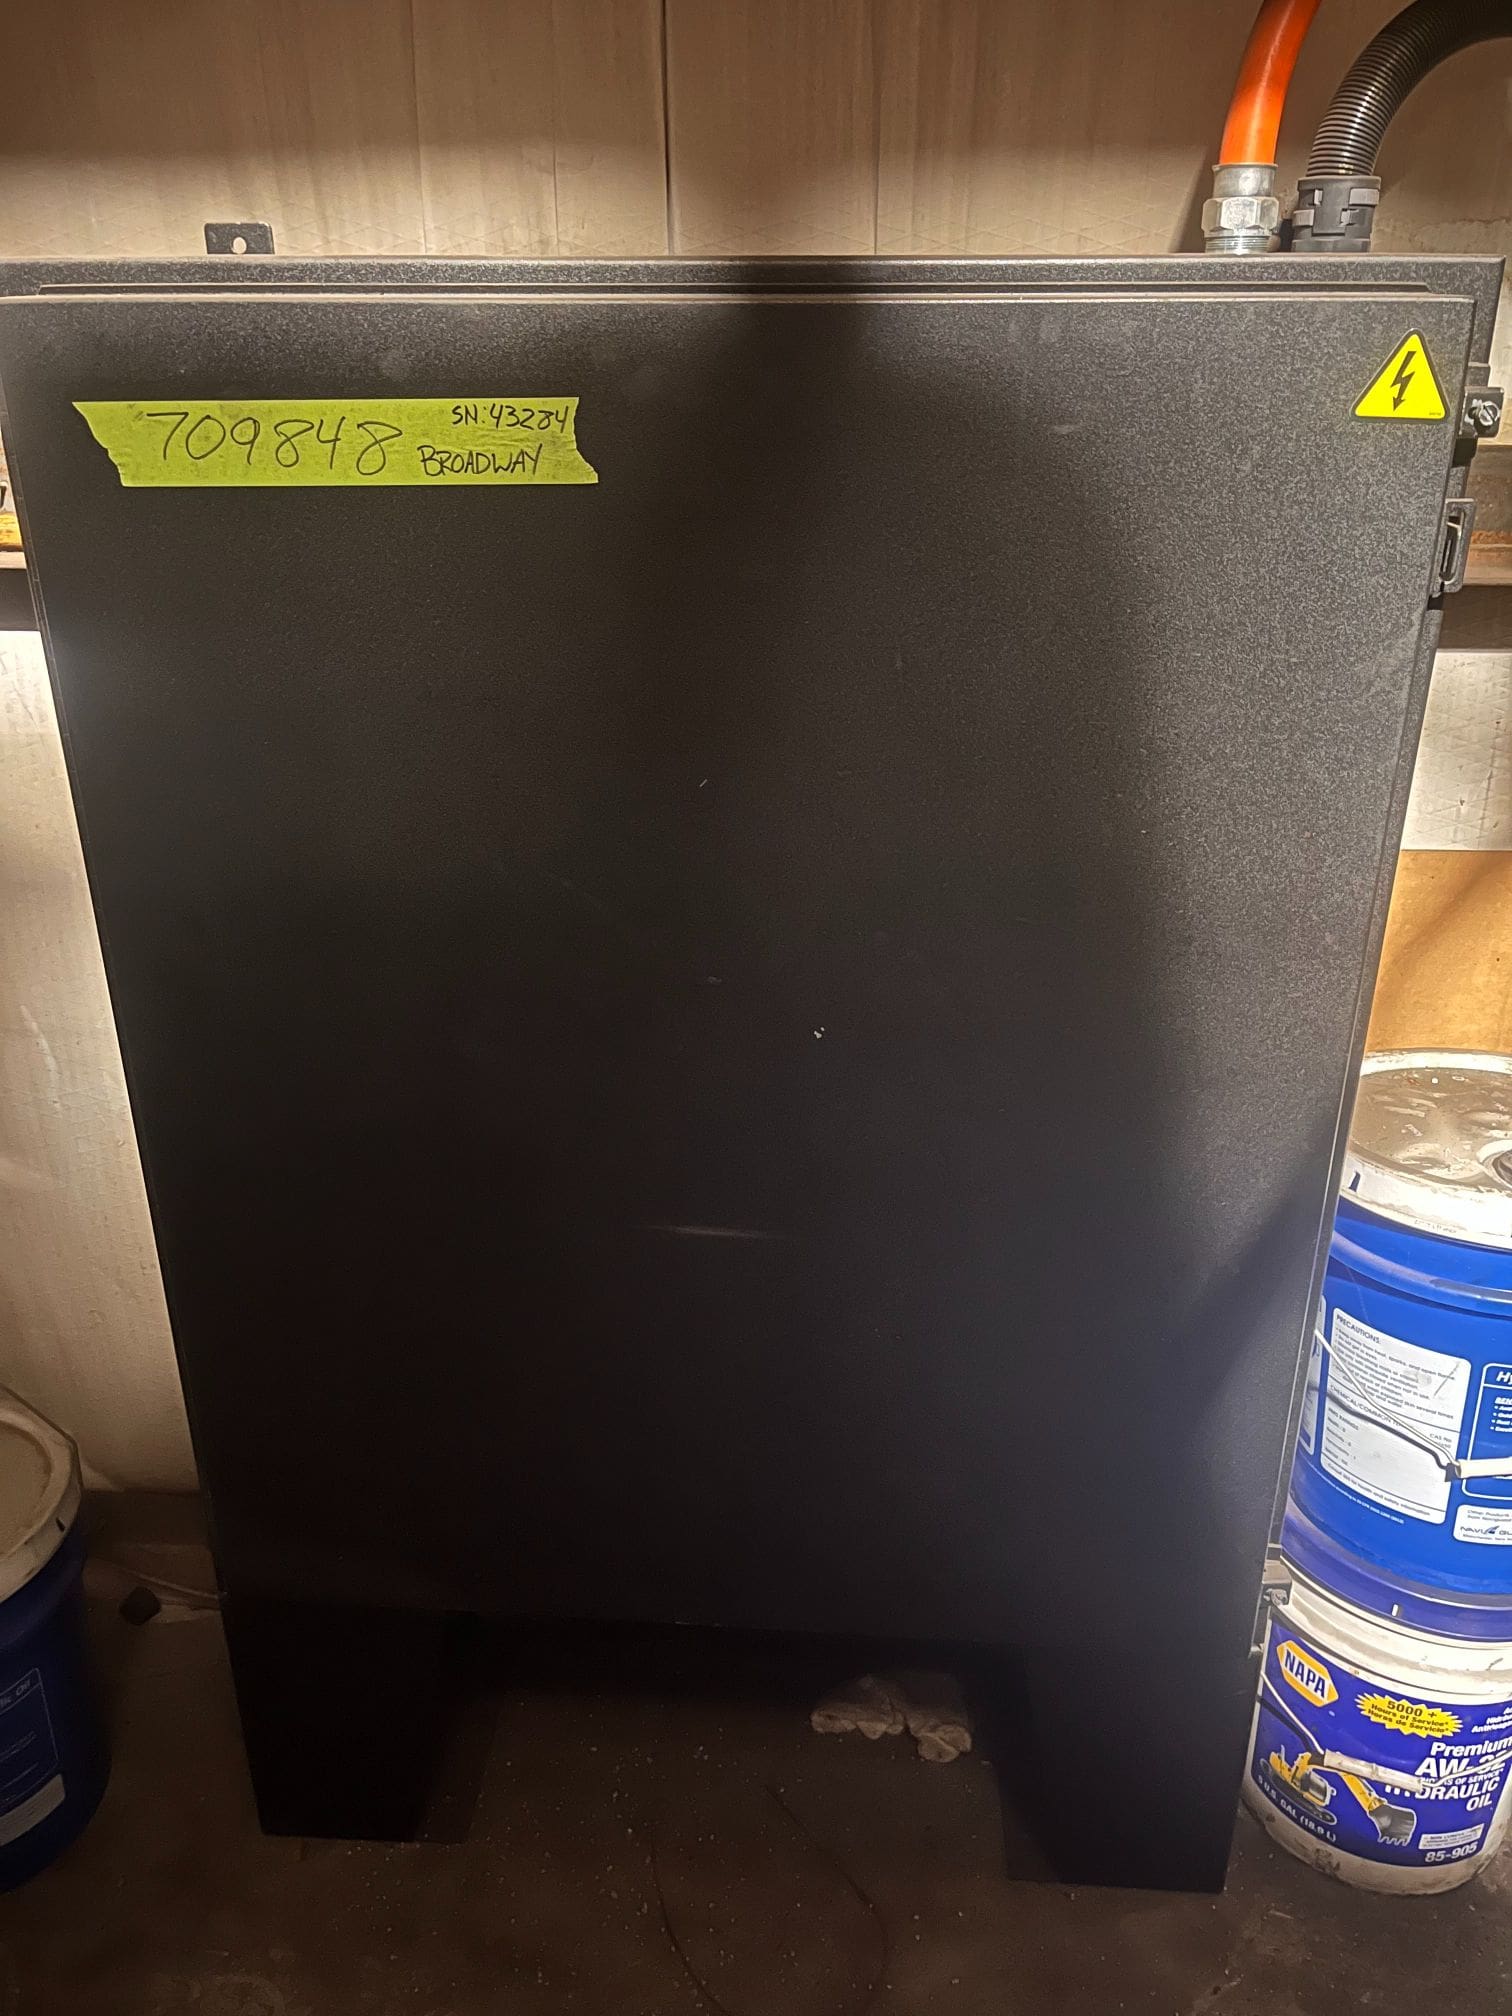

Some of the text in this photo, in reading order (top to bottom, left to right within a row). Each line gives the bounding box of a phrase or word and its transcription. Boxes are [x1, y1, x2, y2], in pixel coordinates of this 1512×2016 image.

[146, 412, 403, 475] 709848
[417, 443, 542, 476] BROADWAY
[1284, 1649, 1326, 1698] NAPA
[1367, 1708, 1393, 1723] Horas
[1395, 1718, 1407, 1726] de
[1371, 1703, 1397, 1717] Hours
[1387, 1700, 1423, 1717] 5000
[1384, 1776, 1501, 1799] DRAULIC
[1466, 1793, 1493, 1811] OIL
[1425, 1842, 1478, 1862] 85-905
